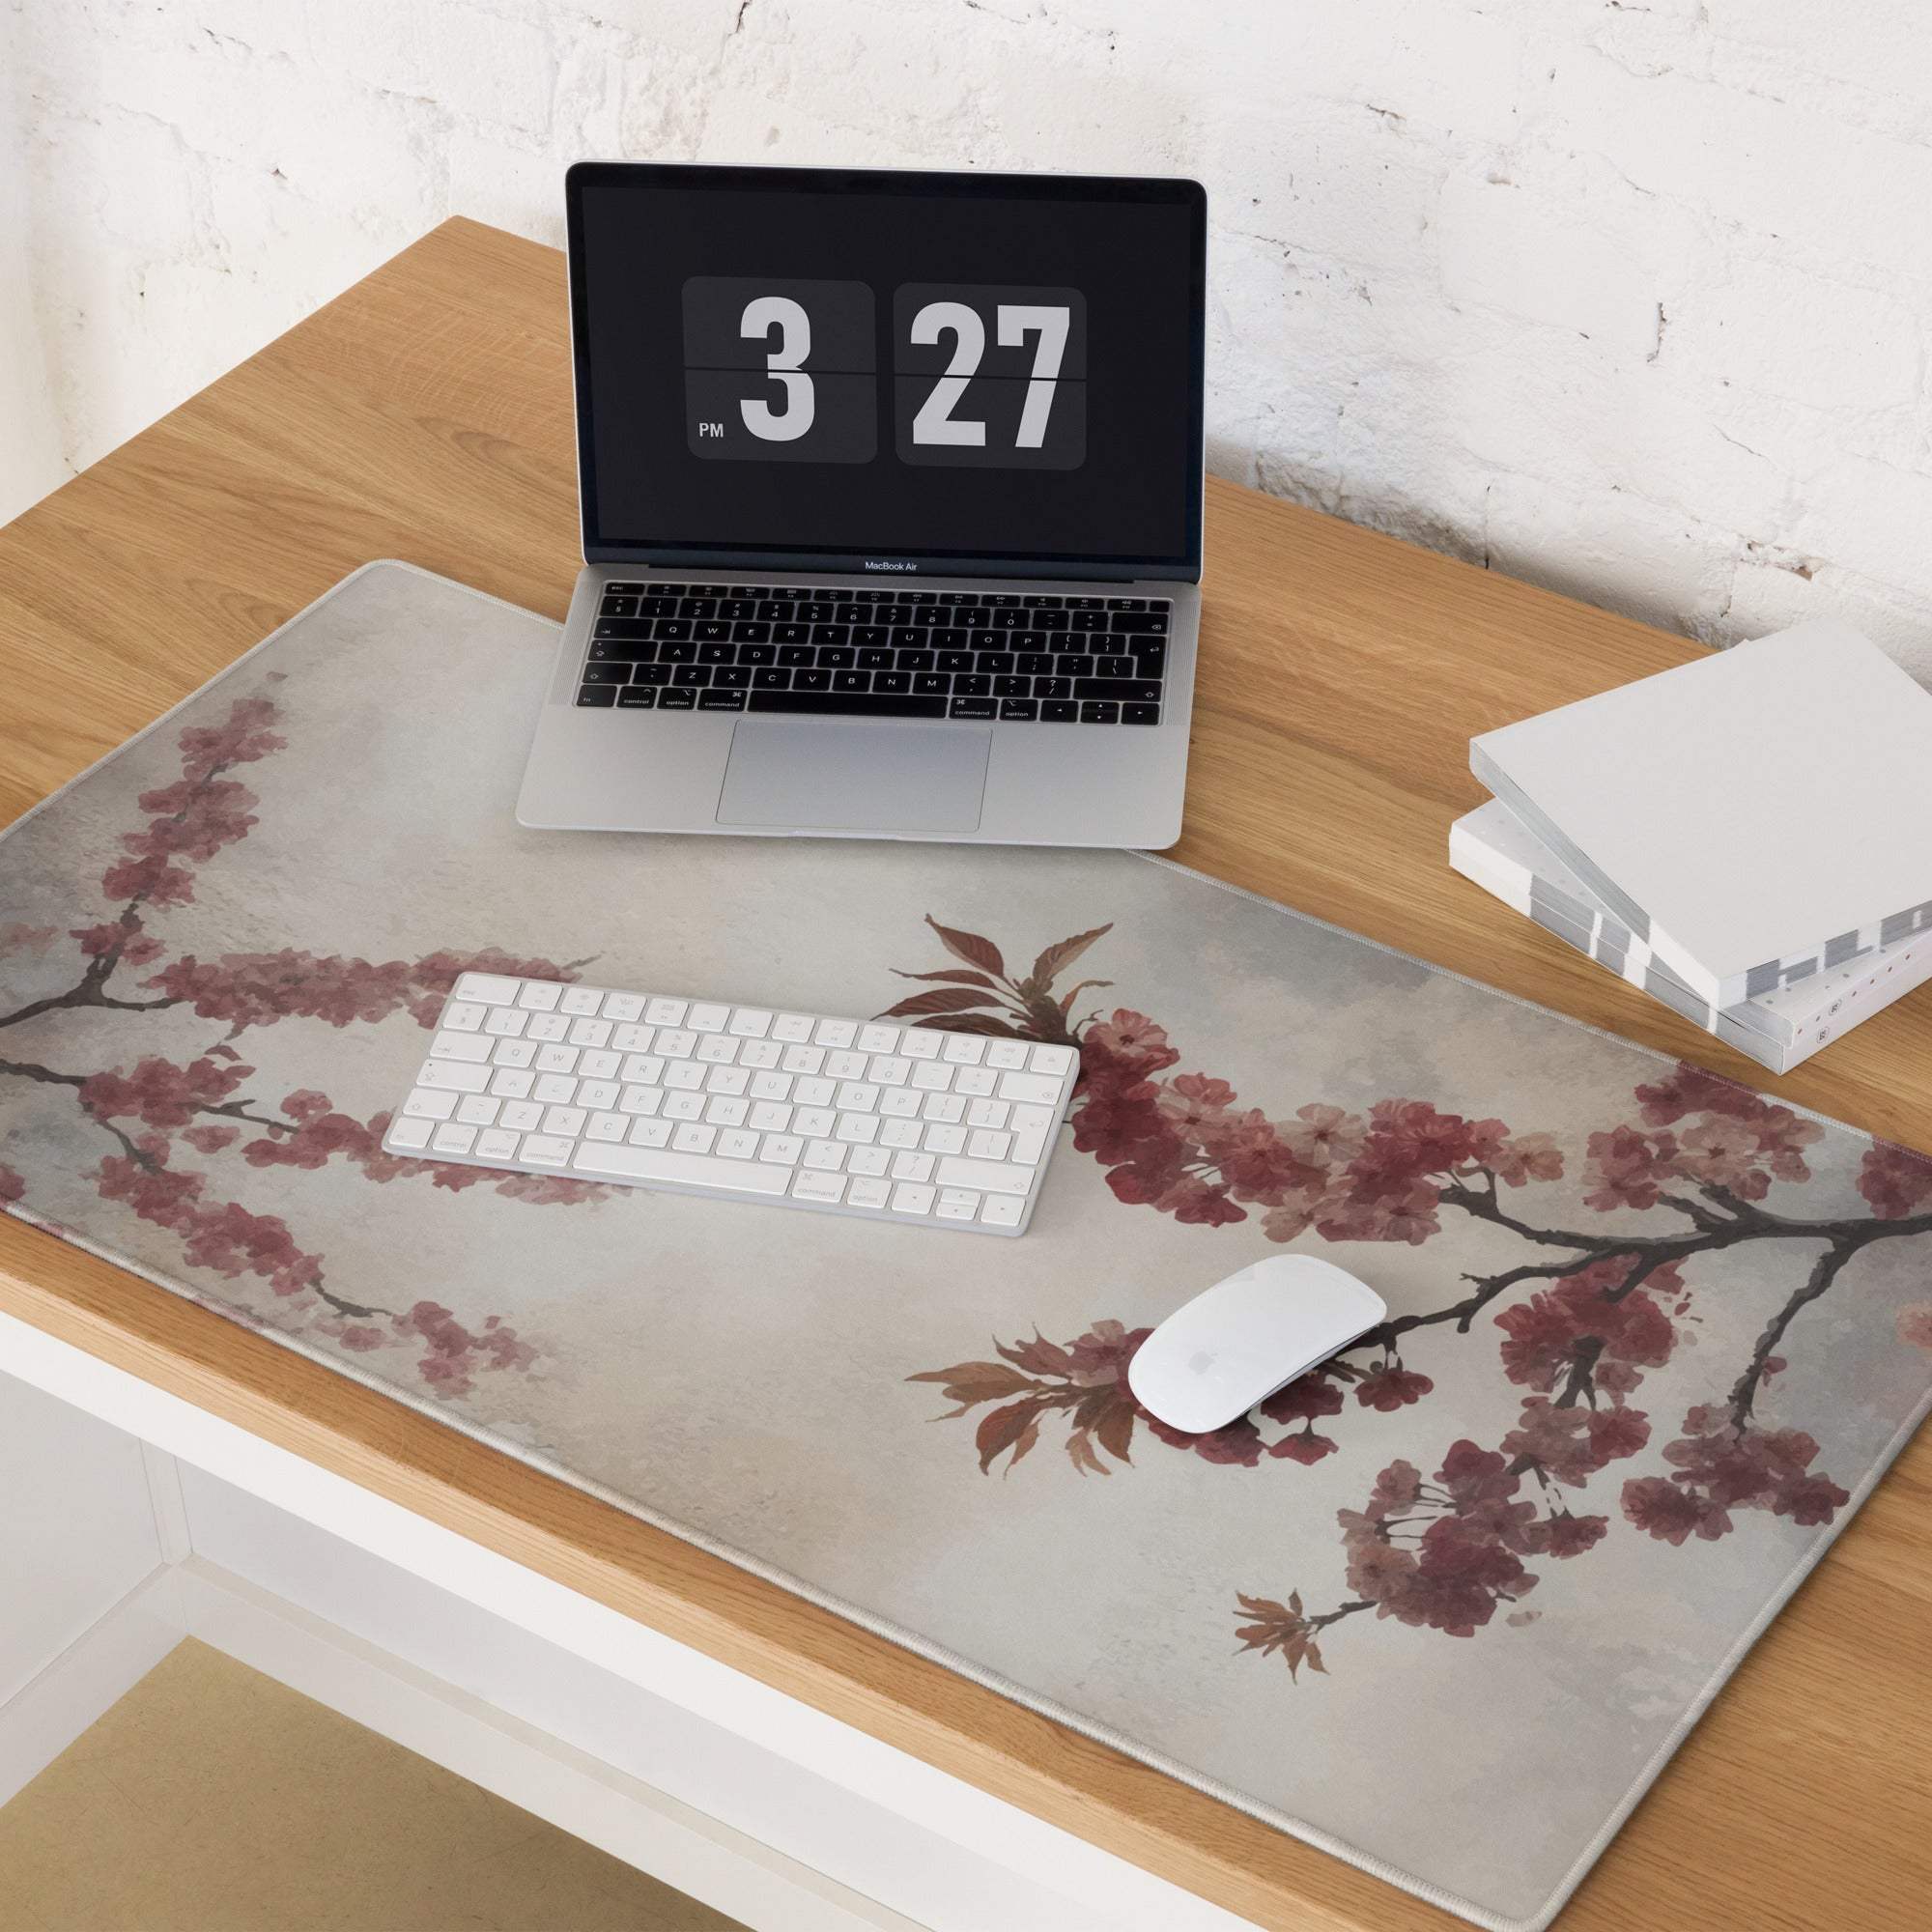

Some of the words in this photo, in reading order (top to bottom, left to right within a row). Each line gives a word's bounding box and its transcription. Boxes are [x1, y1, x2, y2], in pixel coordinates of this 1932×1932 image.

[740, 297, 814, 440] 3
[911, 302, 1069, 447] 27
[698, 422, 724, 438] PM
[866, 561, 904, 571] MacBook
[905, 562, 918, 571] Air
